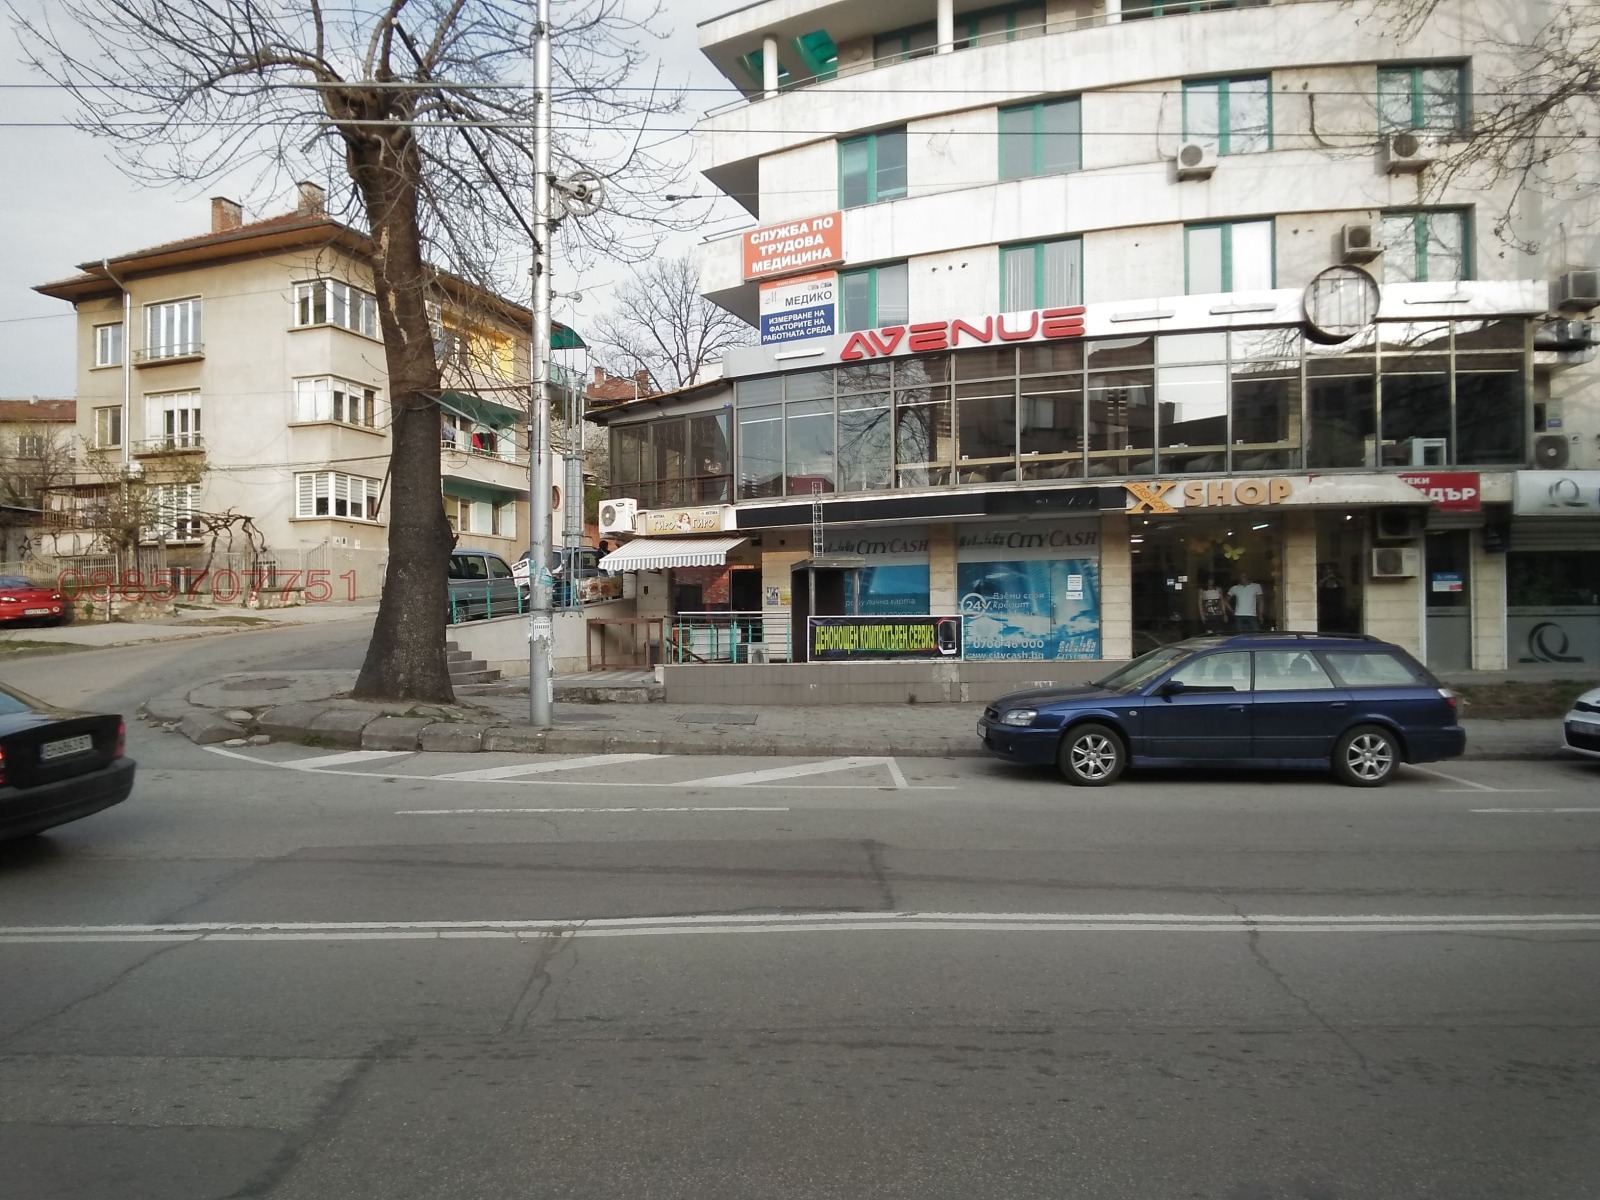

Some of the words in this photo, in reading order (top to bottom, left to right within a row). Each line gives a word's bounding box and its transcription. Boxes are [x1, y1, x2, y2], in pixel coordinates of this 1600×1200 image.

[750, 222, 809, 244] СЛУЖБА
[812, 217, 834, 231] ПО
[759, 233, 824, 256] ТРУДОВА
[752, 247, 832, 273] МЕДИЦИНА
[785, 290, 832, 306] МЕДИКО
[768, 311, 813, 324] ИЗМЕРВАНЕ
[814, 309, 825, 317] НА
[769, 319, 813, 333] ФАКТОРИТЕ
[814, 317, 825, 326] НА
[763, 329, 805, 342] РАБОТНАТА
[806, 325, 832, 335] СРЕДА
[840, 306, 1086, 361] AVENUE
[1122, 481, 1178, 514] X
[1184, 478, 1292, 507] SHOP
[1132, 484, 1170, 512] FASHION
[815, 625, 859, 655] ДЕНОНОЩЕН
[860, 625, 908, 650] КОМПЮТЪРЕН
[909, 624, 935, 649] СЕРВИЗ
[973, 640, 1000, 649] 0700
[1021, 640, 1045, 649] 000
